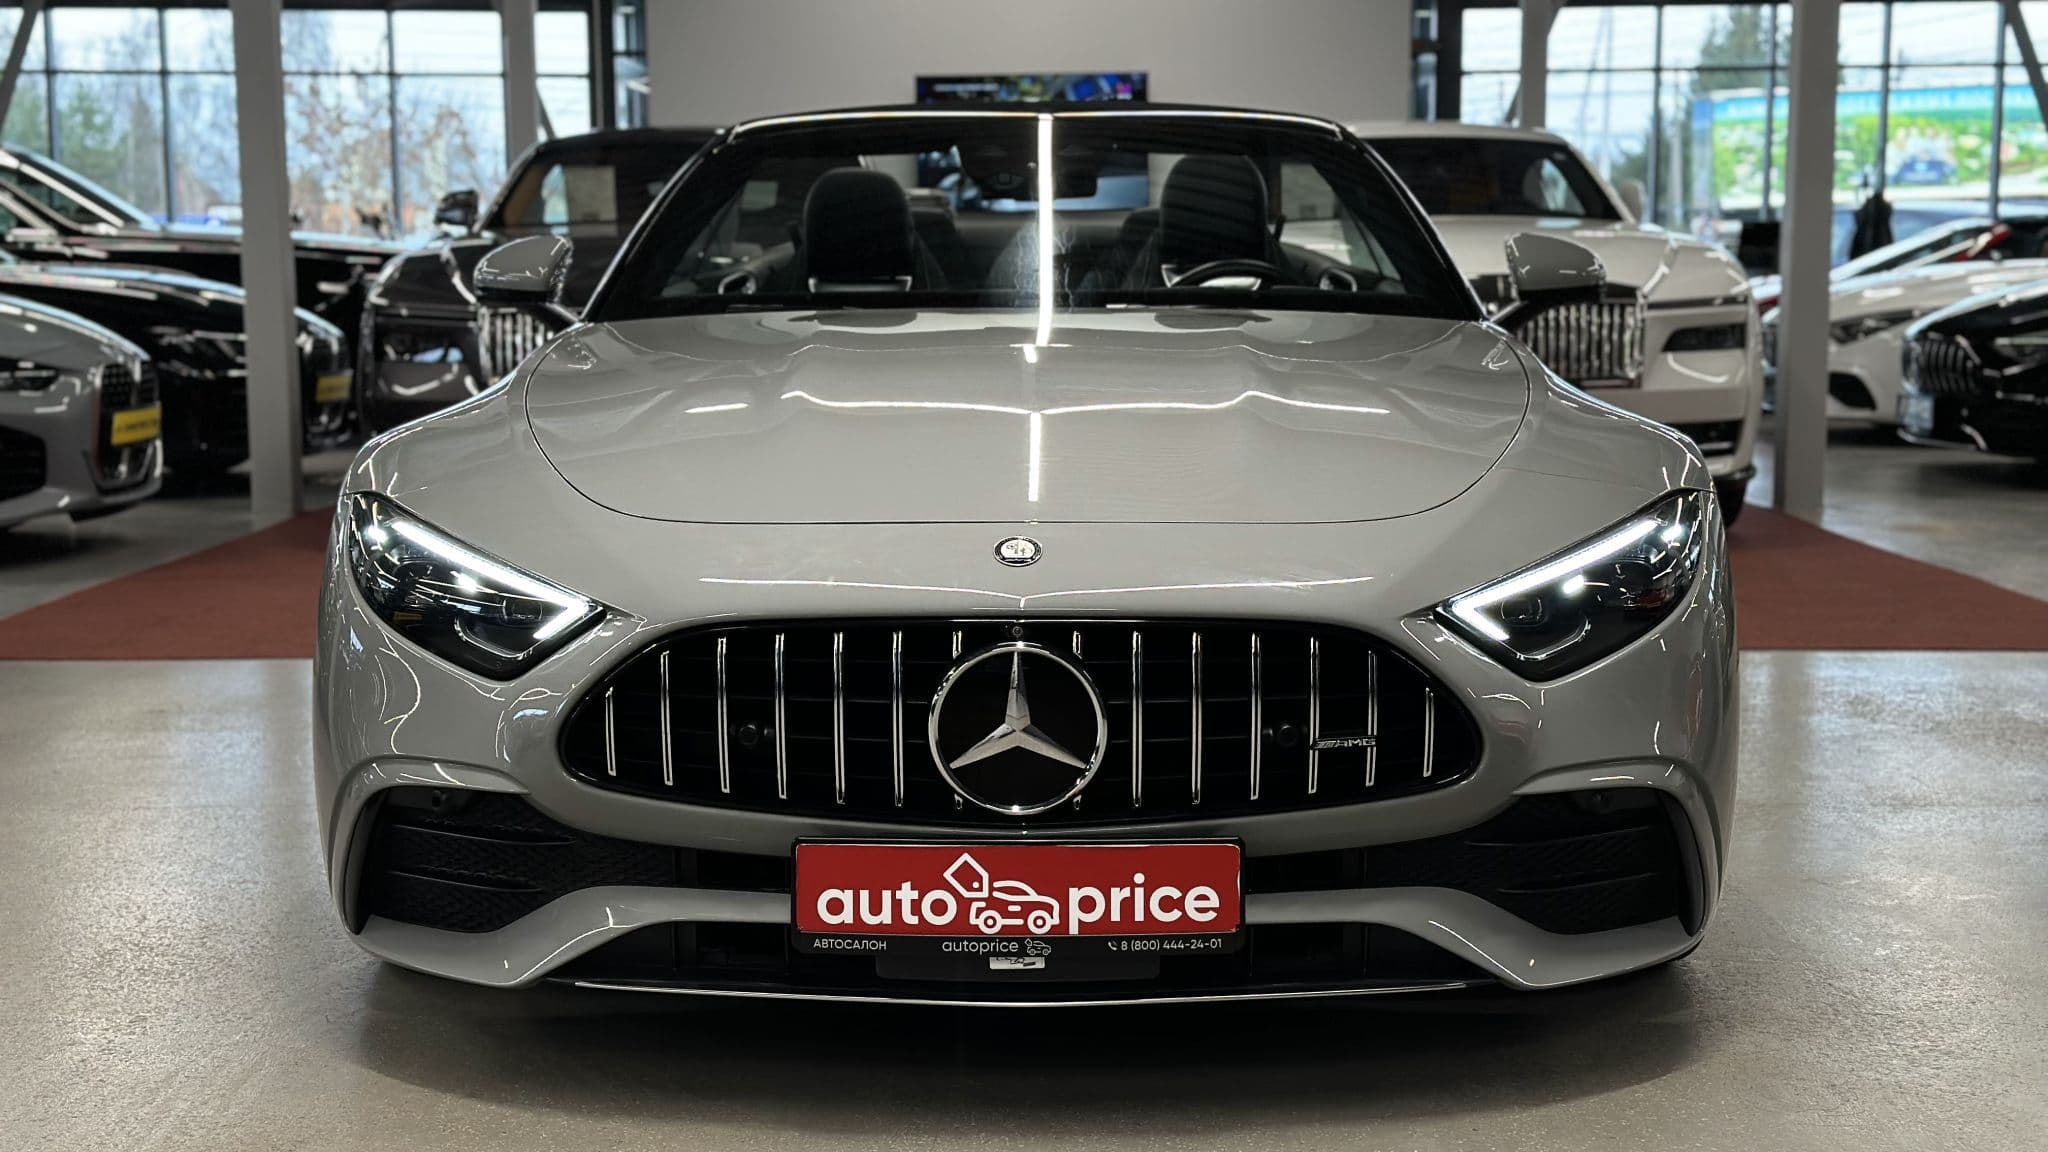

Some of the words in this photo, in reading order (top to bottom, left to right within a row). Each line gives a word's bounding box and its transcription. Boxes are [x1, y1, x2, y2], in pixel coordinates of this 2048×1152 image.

[1335, 738, 1376, 747] AMG
[816, 881, 958, 925] auto
[1068, 872, 1220, 934] price
[813, 938, 887, 951] АВТОСАЛОН
[941, 939, 1019, 955] autoprice
[1121, 940, 1128, 951] 8
[1131, 939, 1160, 951] (800)
[1163, 938, 1222, 949] 444-24-01
